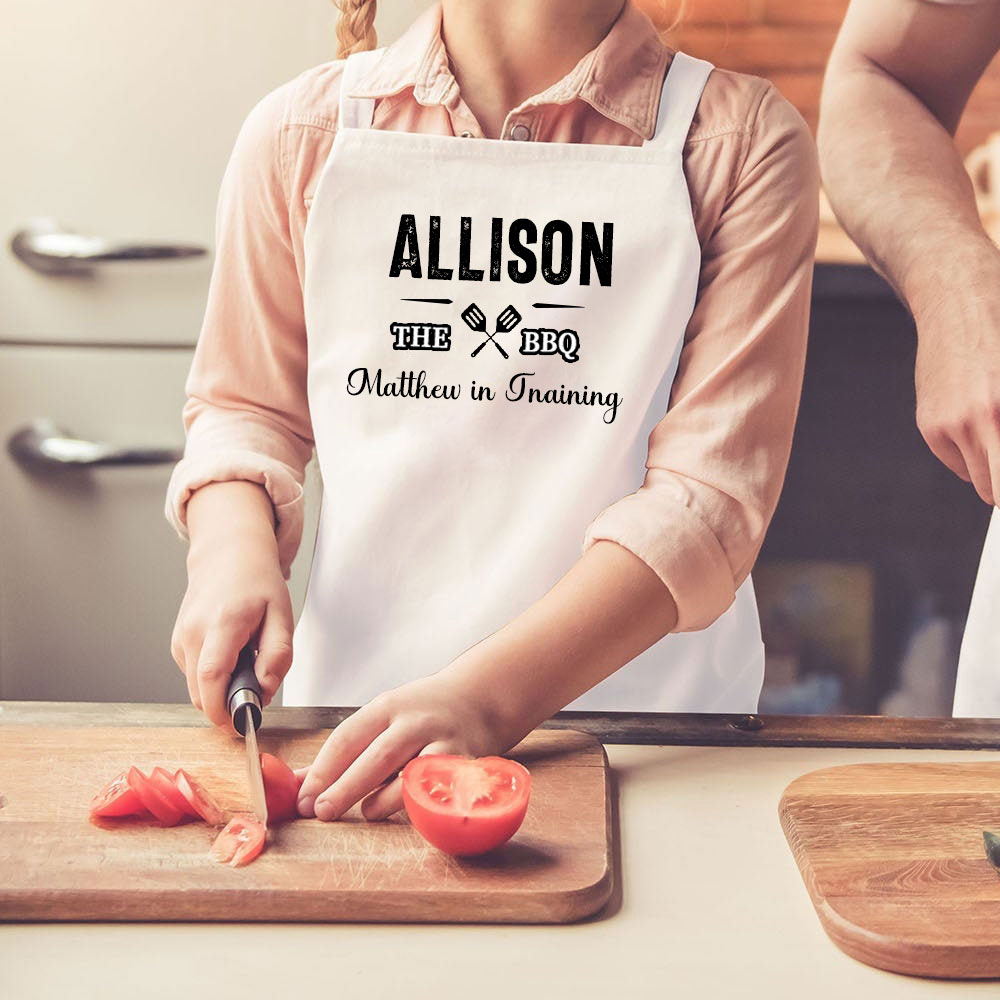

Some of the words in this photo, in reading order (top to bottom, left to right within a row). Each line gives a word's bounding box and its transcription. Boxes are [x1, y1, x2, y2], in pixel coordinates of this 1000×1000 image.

[389, 214, 614, 287] ALLISON
[390, 322, 451, 351] THE
[519, 328, 580, 363] BBQ
[346, 367, 461, 400] Matthew
[470, 380, 496, 401] in
